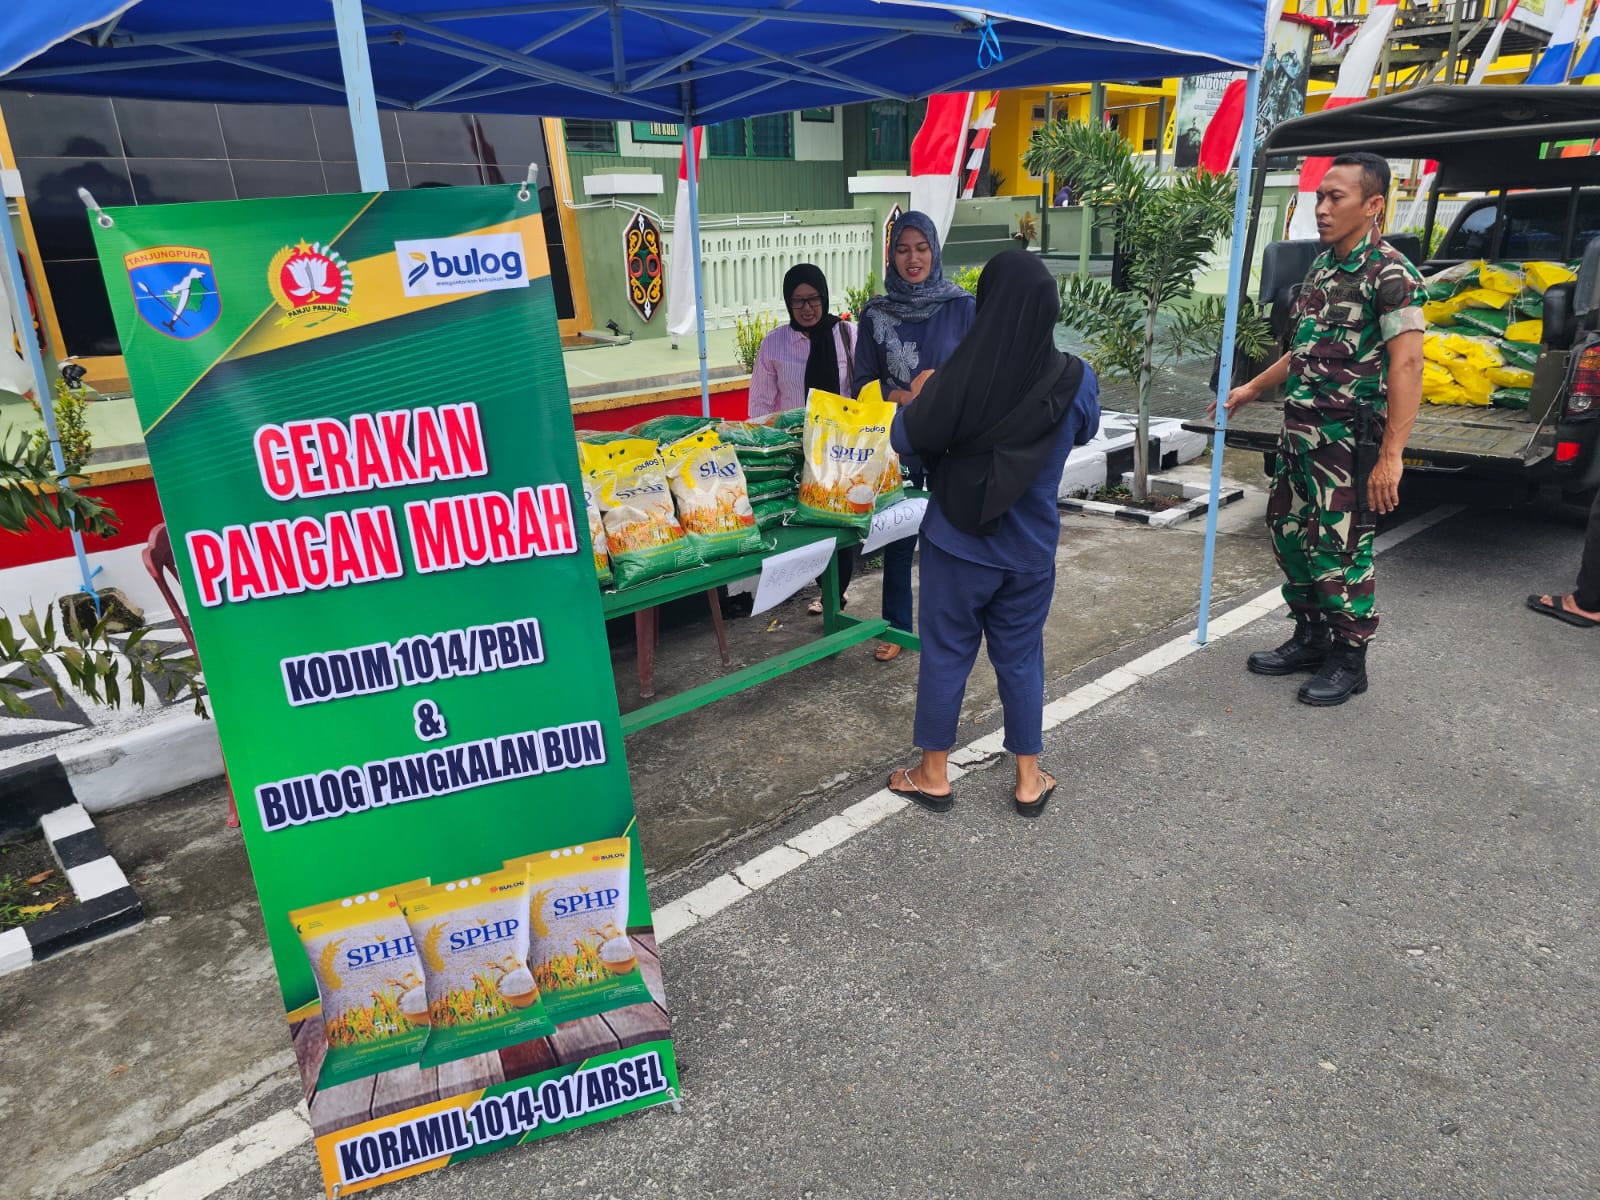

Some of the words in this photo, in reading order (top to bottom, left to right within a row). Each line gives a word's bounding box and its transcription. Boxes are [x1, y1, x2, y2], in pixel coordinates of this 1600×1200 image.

[128, 249, 207, 266] TANJUNGPURA
[430, 248, 522, 280] bulog
[288, 306, 311, 319] PANJU
[312, 304, 348, 314] PANJUNG
[865, 425, 886, 434] bulog
[255, 403, 487, 500] GERAKAN
[185, 505, 403, 607] PANGAN
[405, 484, 577, 573] MURAH
[281, 642, 397, 706] KODIM
[394, 618, 544, 686] 1014/PBN
[414, 700, 446, 741] &
[255, 765, 370, 831] BULOG
[363, 732, 543, 807] PANGKALAN
[538, 721, 606, 772] BUN
[553, 887, 619, 918] SPHP
[450, 918, 519, 951] SPHP
[336, 1107, 472, 1185] KORAMIL
[468, 1052, 667, 1147] 1014-01/ARSEL
